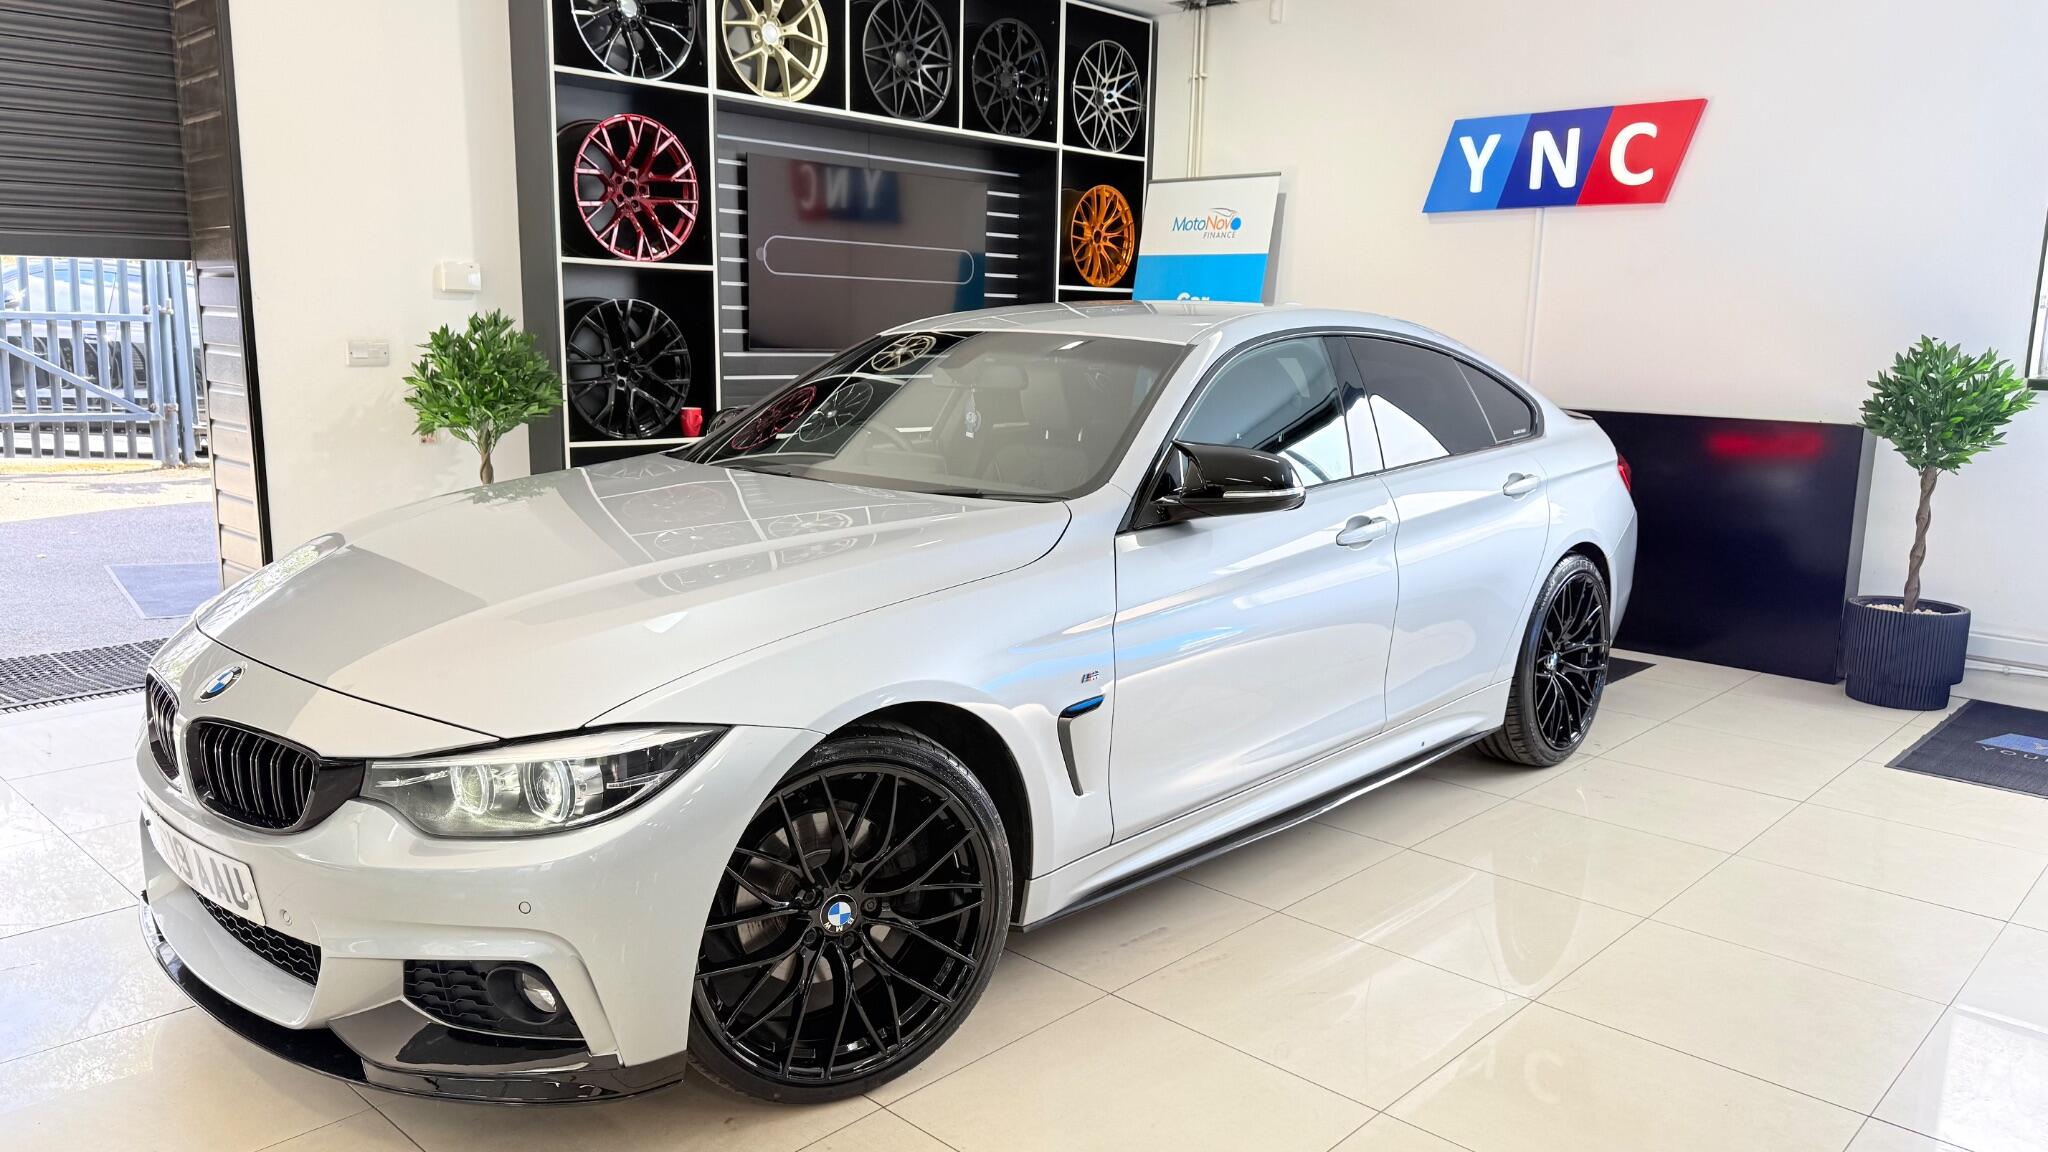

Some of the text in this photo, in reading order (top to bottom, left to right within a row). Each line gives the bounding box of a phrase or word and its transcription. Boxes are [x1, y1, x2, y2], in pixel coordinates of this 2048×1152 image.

[1459, 122, 1658, 193] YNC
[1203, 231, 1236, 239] FINANCE
[194, 848, 249, 911] AAU
